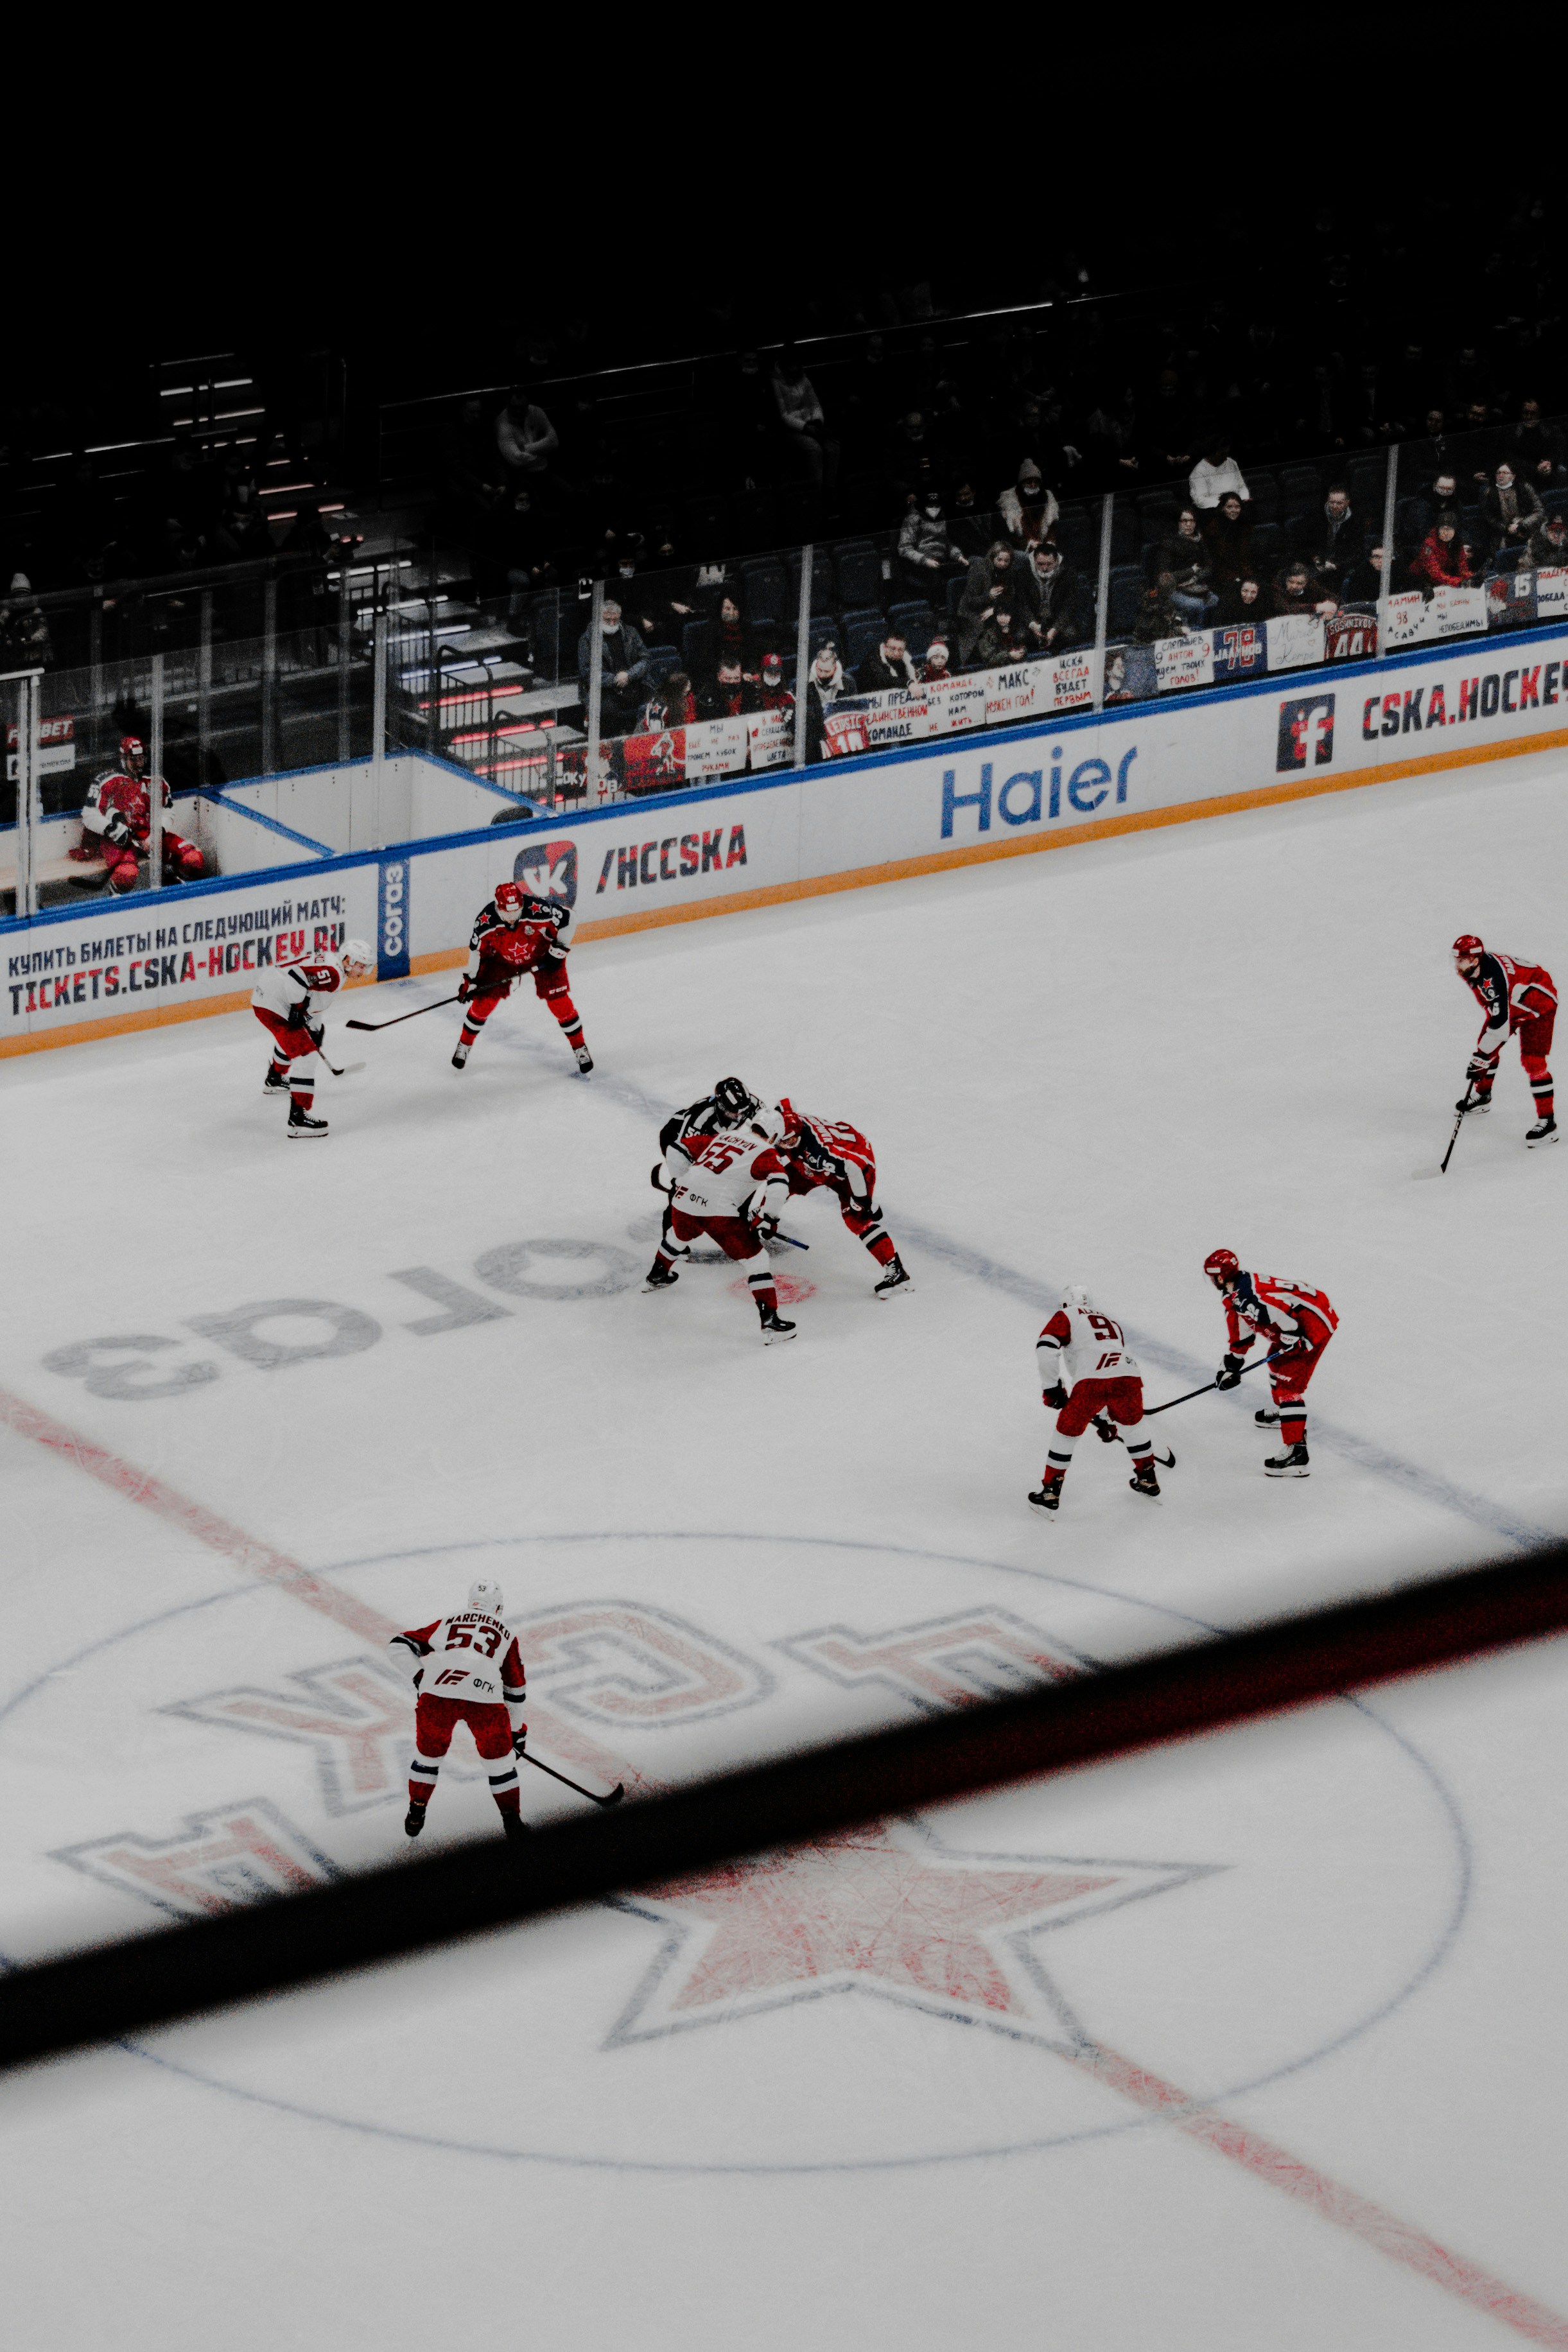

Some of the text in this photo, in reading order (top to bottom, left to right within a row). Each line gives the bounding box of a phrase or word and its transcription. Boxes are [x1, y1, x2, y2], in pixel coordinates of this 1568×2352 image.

[1397, 611, 1408, 626] 98
[1334, 631, 1364, 658] 44
[998, 668, 1029, 691] МАКС
[1053, 666, 1090, 683] ВСЕГДА
[1054, 691, 1092, 707] ПЕРВЫМ
[1056, 679, 1087, 695] БУДЕТ
[948, 706, 966, 716] НАМ
[8, 720, 74, 745] FBET
[941, 745, 1138, 839] Haier
[596, 824, 747, 894] /HCCSKA
[9, 895, 345, 977] КУПИТЬ БИЛЕТЫ НА СЛЕДУЮЩИЙ МАТЧ:
[693, 1142, 744, 1175] 55
[689, 1193, 708, 1207] ФГК
[445, 1613, 511, 1641] MARCHENKO
[445, 1624, 502, 1659] 53
[473, 1678, 495, 1694] ФГК
